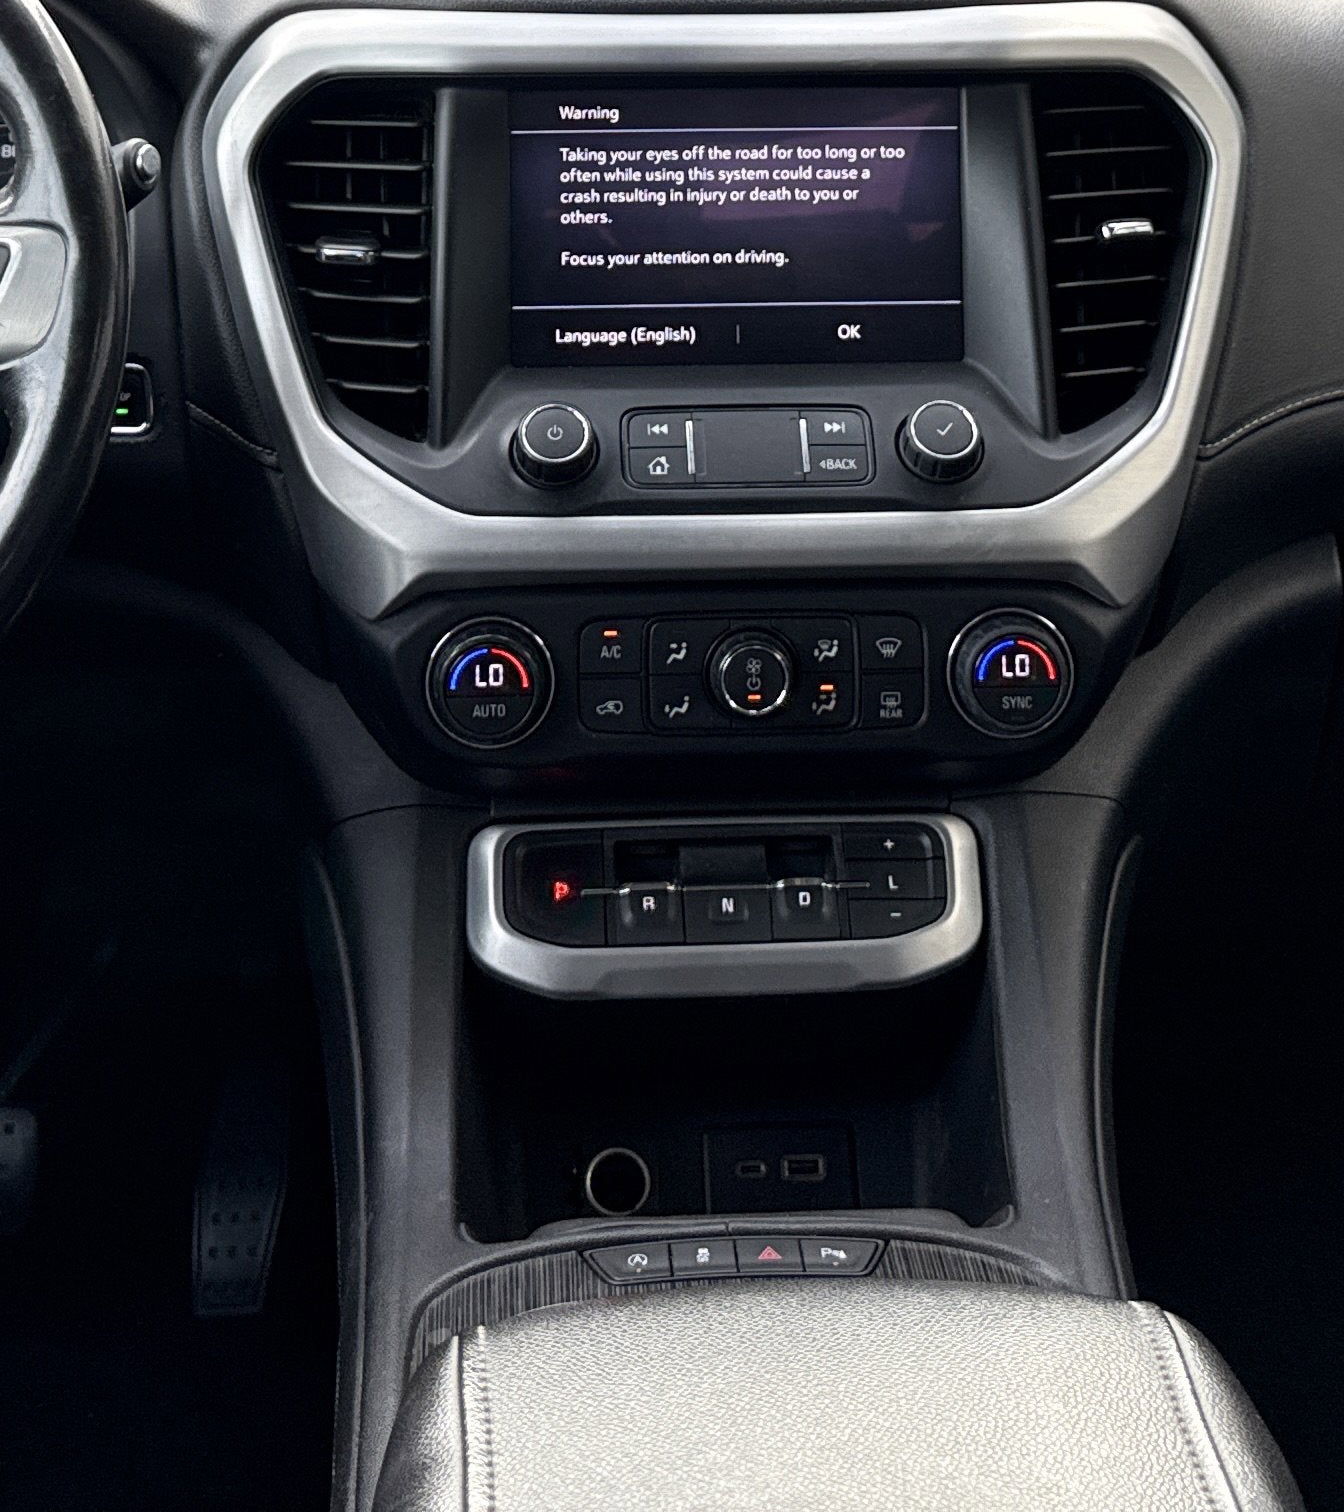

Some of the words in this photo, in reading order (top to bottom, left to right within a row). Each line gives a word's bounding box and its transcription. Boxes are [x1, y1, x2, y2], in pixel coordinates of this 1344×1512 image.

[559, 106, 619, 123] Warning
[559, 147, 606, 163] Taking
[610, 149, 643, 164] your
[646, 149, 679, 163] eyes
[682, 145, 705, 161] off
[707, 146, 732, 160] the
[735, 145, 768, 160] road
[772, 145, 793, 159] for
[796, 146, 822, 159] too
[825, 144, 857, 162] long
[860, 147, 877, 159] or
[879, 145, 905, 159] too
[559, 167, 601, 183] often
[604, 167, 642, 182] while
[646, 168, 685, 185] using
[688, 166, 714, 181] this
[718, 168, 769, 185] system
[772, 165, 812, 180] could
[815, 168, 858, 180] cause
[861, 169, 870, 180] a
[559, 188, 600, 203] crash
[603, 187, 666, 206] resulting
[669, 188, 683, 202] in
[686, 188, 727, 206] injury
[730, 190, 746, 201] or
[750, 186, 791, 201] death
[794, 188, 809, 201] to
[812, 189, 839, 204] you
[842, 188, 859, 200] or
[559, 209, 613, 225] others.
[561, 251, 604, 266] Focus
[607, 253, 640, 269] your
[643, 250, 709, 265] attention
[713, 253, 732, 264] on
[735, 249, 789, 267] driving.
[556, 329, 627, 346] Language
[630, 326, 696, 346] (English)
[837, 324, 861, 339] OK
[827, 458, 857, 471] BACK
[600, 645, 622, 659] A/C
[1001, 653, 1030, 678] LO
[474, 663, 505, 688] LO
[472, 703, 506, 718] AUTO
[1001, 695, 1033, 711] SYNC
[879, 708, 903, 719] REAR
[554, 881, 570, 900] P
[888, 876, 899, 891] L
[642, 897, 656, 912] R
[722, 897, 735, 913] N
[799, 891, 812, 906] D
